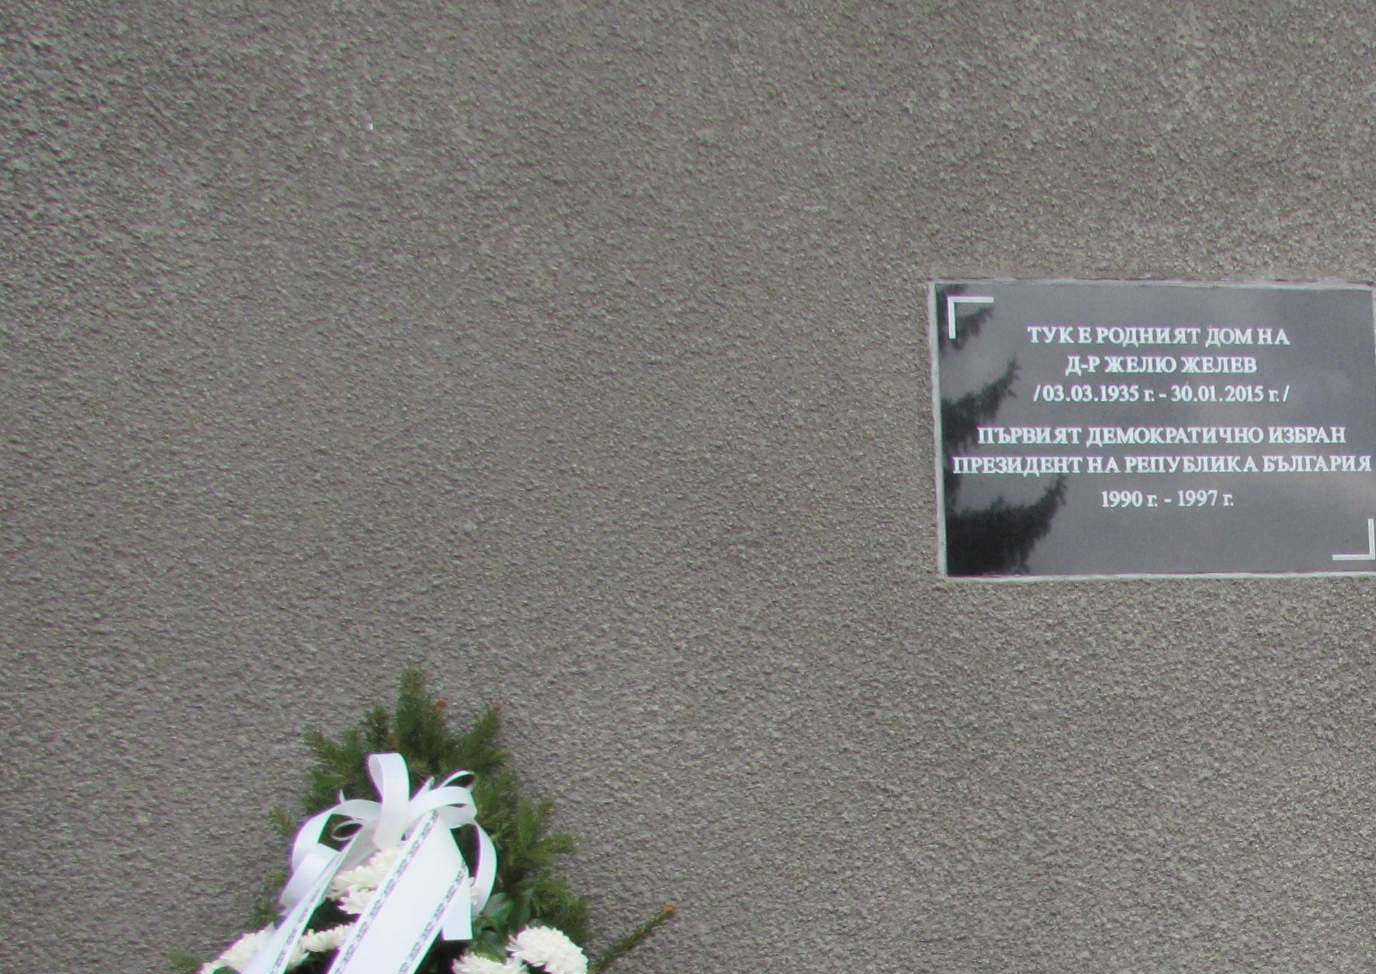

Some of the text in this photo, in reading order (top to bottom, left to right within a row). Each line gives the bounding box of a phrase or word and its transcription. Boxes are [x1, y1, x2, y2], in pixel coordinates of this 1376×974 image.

[1027, 326, 1291, 348] ТУК Е РОДНИЯТ ДОМ НА
[1065, 355, 1258, 376] Д-Р ЖЕЛЮ ЖЕЛЕВ
[1171, 384, 1264, 403] 30.01.2015
[977, 426, 1347, 448] ПЪРВИЯТ ДЕМОКРАТИЧНО ИЗБРАН
[953, 455, 1373, 477] ПРЕЗИДЕНТ НА РЕПУБЛИКА БЪЛГАРИЯ
[1101, 490, 1143, 508] 1990
[1177, 489, 1219, 507] 1997
